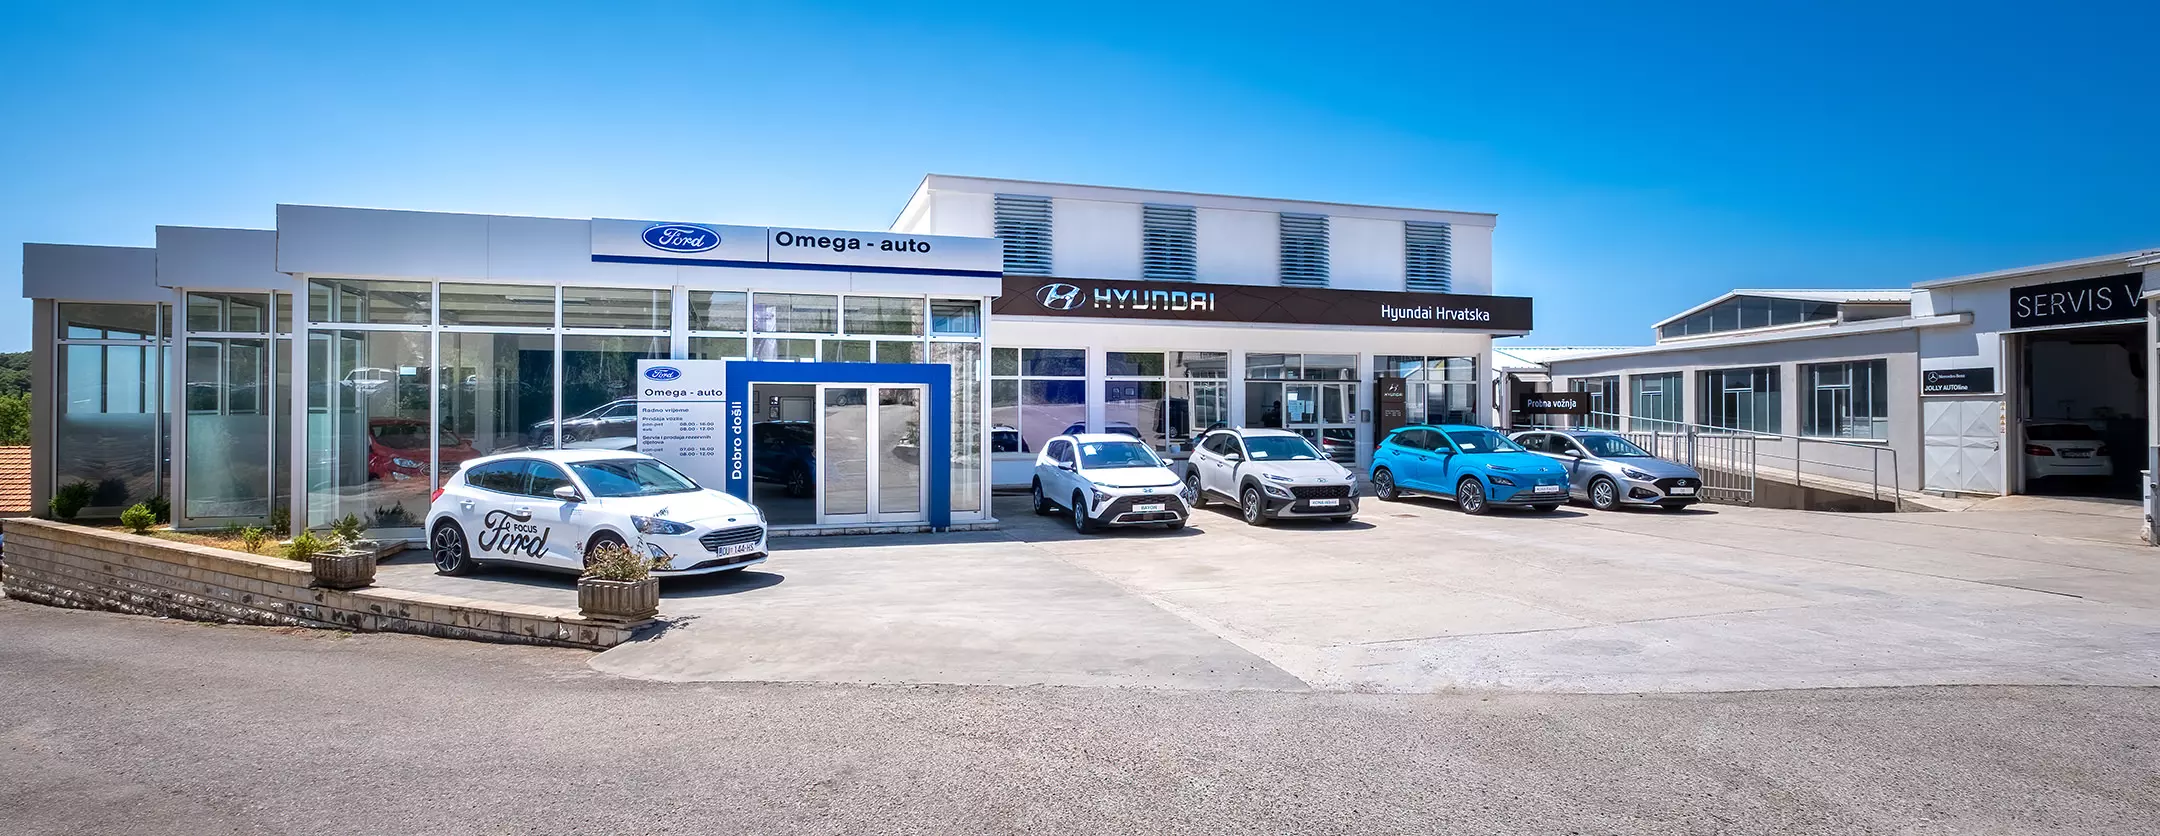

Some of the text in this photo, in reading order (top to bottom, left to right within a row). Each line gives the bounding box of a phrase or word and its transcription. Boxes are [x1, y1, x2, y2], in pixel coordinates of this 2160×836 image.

[659, 228, 705, 247] Ford
[776, 231, 860, 252] Omega
[881, 239, 931, 253] auto
[1094, 288, 1215, 312] HYUNDAI
[2017, 286, 2112, 318] SERVIS
[1381, 304, 1490, 321] Hyundai Hrvatska
[652, 369, 674, 378] Ford
[644, 388, 687, 398] Omega
[697, 389, 723, 397] auto
[1527, 398, 1577, 410] Probna vožnja
[731, 401, 742, 480] Dobro došli
[478, 509, 550, 559] Ford
[514, 523, 538, 534] FOCUS
